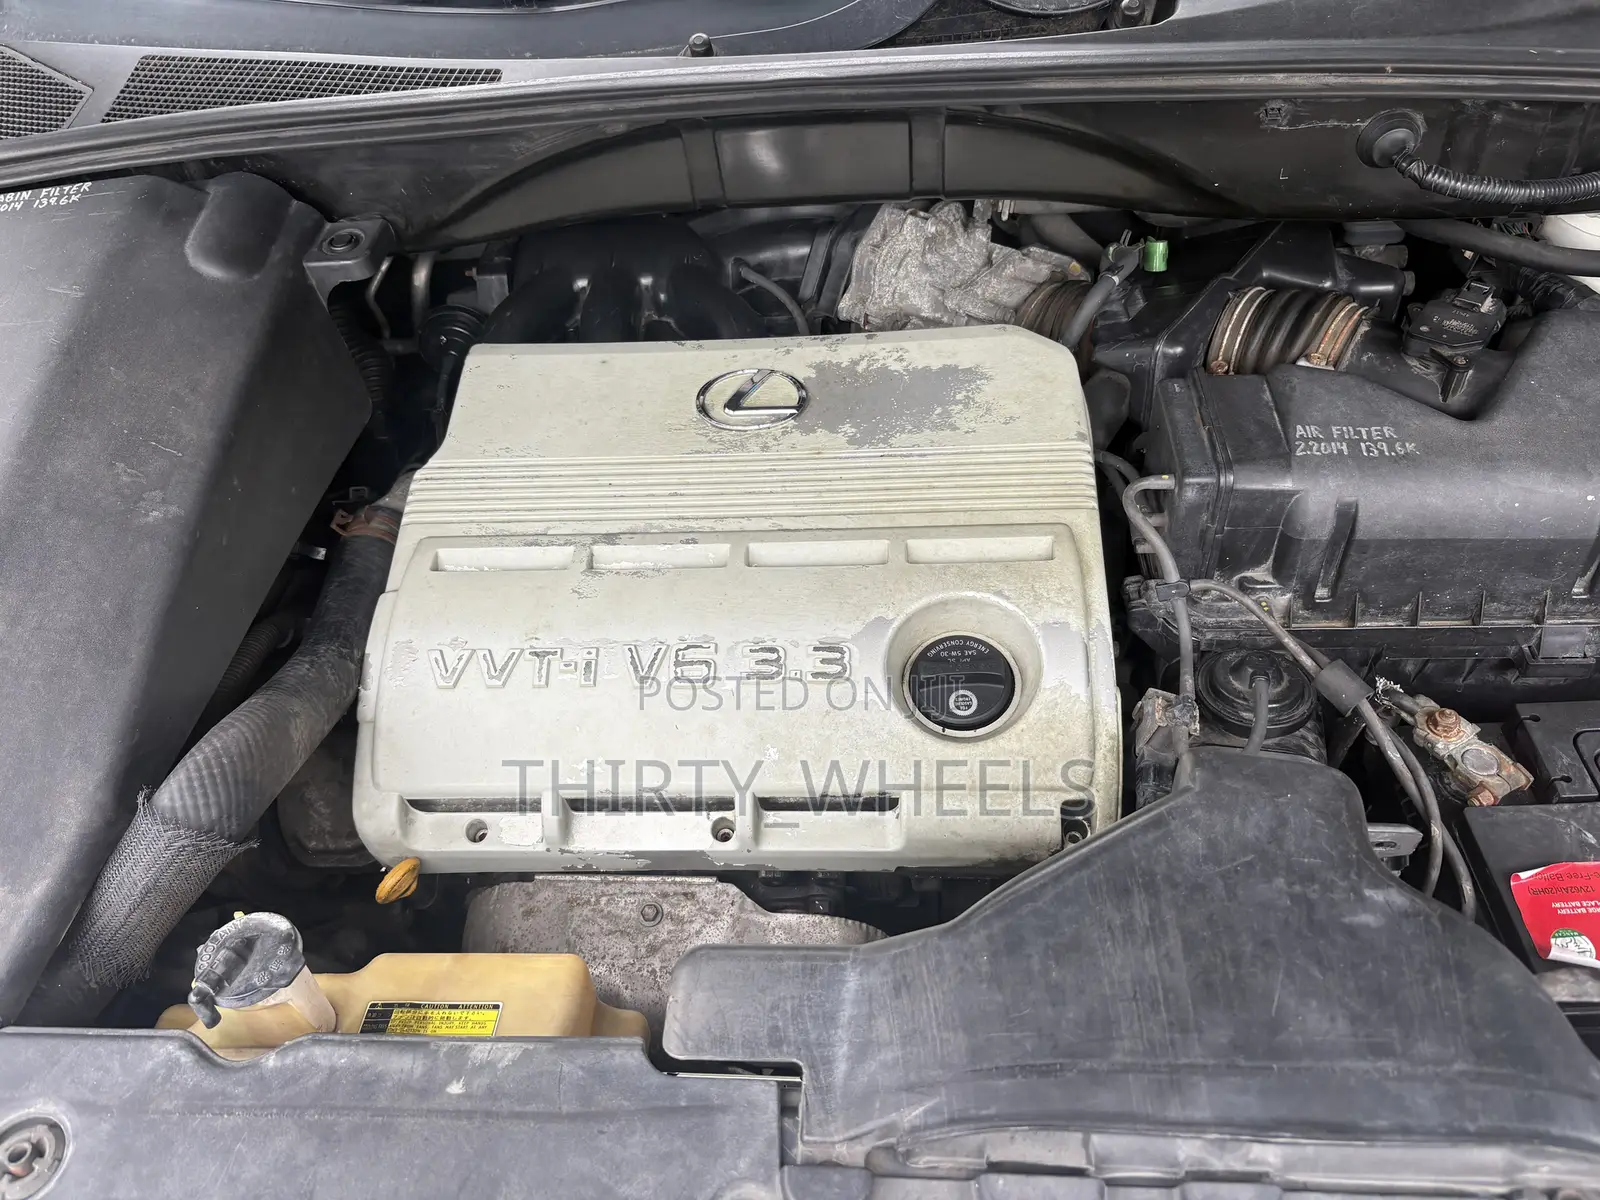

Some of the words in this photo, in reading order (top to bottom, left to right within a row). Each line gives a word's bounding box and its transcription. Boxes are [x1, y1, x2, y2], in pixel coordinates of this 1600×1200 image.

[40, 181, 92, 198] FILTER
[33, 193, 82, 209] 139.6K
[1295, 425, 1325, 439] AIR
[1331, 426, 1399, 440] FILTER
[1360, 441, 1421, 457] 139.6K
[926, 639, 964, 658] CONSERVING
[940, 650, 962, 658] 5W-30
[965, 640, 990, 654] ENERGY
[622, 641, 718, 690] V6
[739, 643, 851, 685] 3.3
